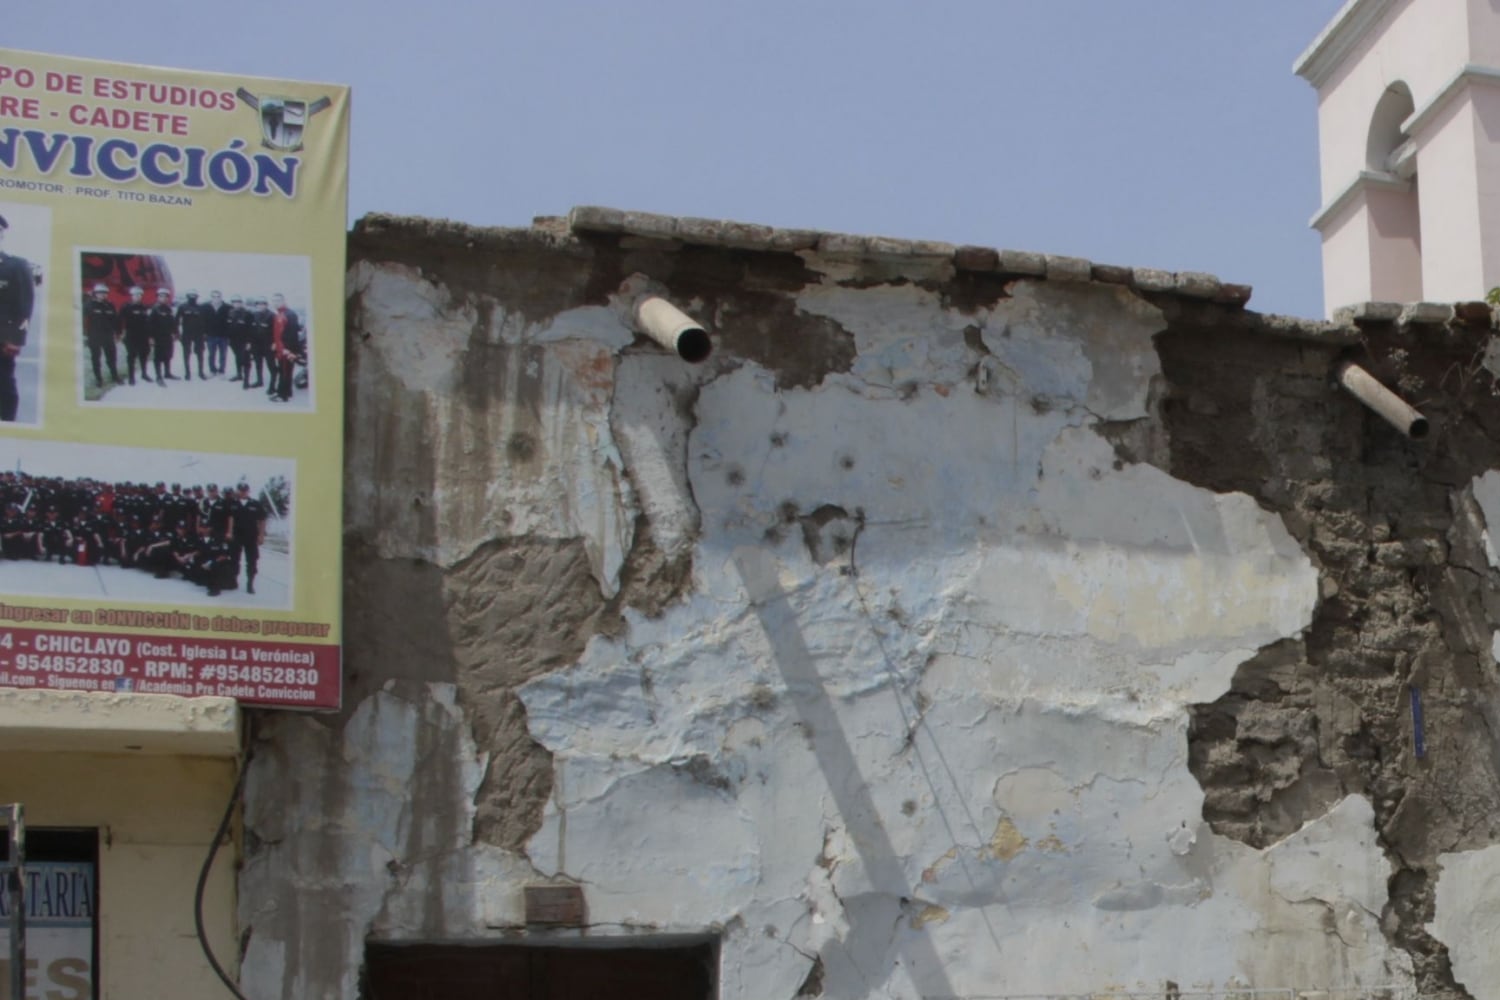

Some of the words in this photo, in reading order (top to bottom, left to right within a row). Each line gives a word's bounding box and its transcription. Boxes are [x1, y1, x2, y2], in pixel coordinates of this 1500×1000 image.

[45, 72, 83, 95] DE
[93, 77, 236, 111] ESTUDIOS
[0, 96, 39, 119] RE
[69, 104, 188, 136] CADETE
[117, 191, 145, 202] TITO
[149, 193, 193, 206] BAZAN
[71, 610, 93, 625] en
[95, 608, 191, 631] CONVICCIÓN
[193, 614, 210, 631] te
[211, 614, 261, 634] debes
[262, 620, 330, 638] preparar
[35, 634, 131, 656] CHICLAYO
[137, 642, 177, 658] (Cost.
[182, 645, 228, 660] Iglesia
[231, 647, 247, 661] La
[251, 648, 315, 667] Verónica)
[16, 653, 125, 675] 954852830
[145, 661, 193, 680] RPM:
[199, 664, 318, 685] #954852830
[101, 680, 115, 691] en
[195, 683, 214, 696] Pre
[217, 683, 255, 698] Cadete
[257, 686, 316, 700] Conviccion
